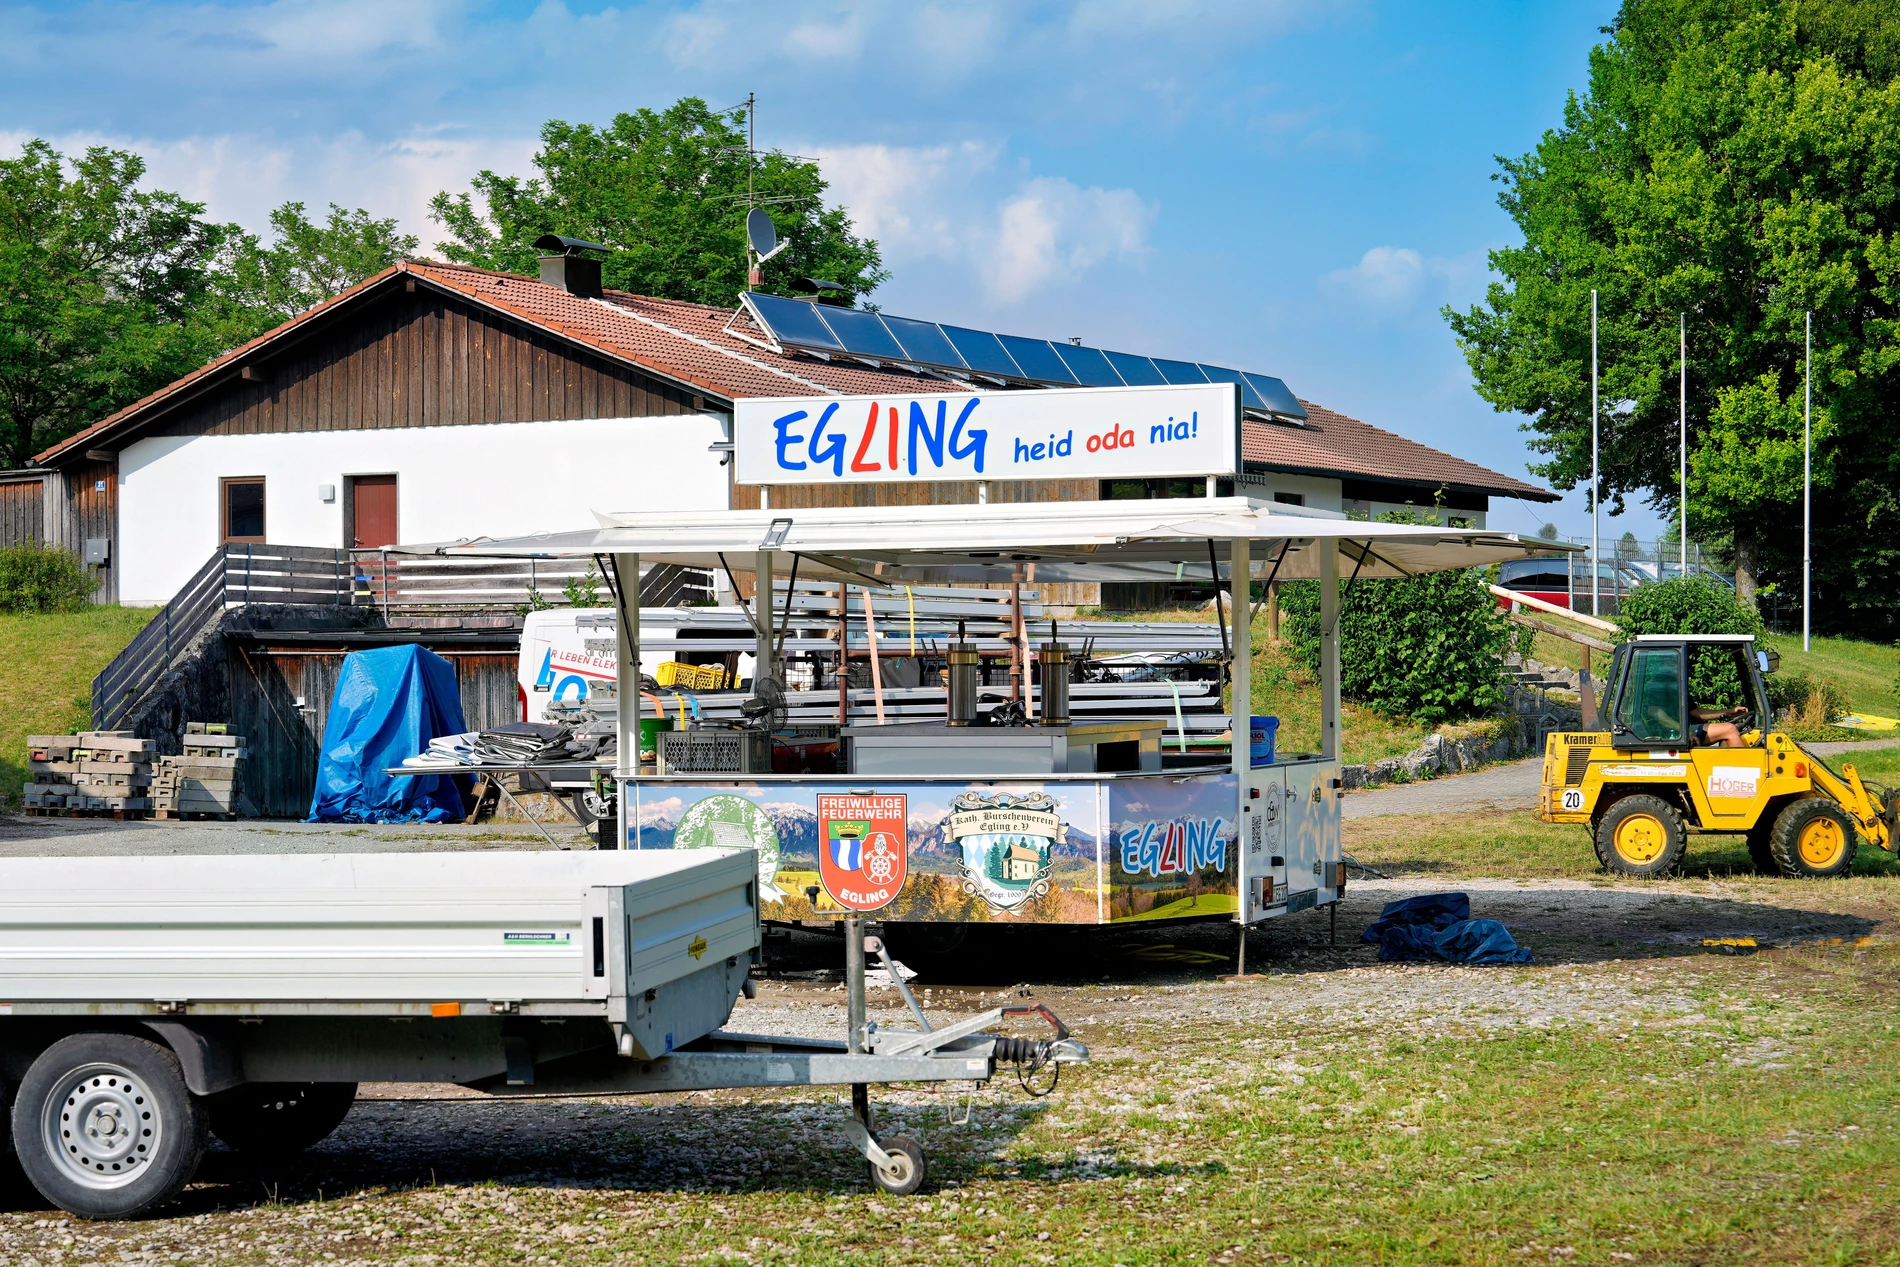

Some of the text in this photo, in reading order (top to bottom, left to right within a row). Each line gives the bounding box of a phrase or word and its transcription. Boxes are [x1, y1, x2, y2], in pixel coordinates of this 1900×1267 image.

[773, 397, 1199, 477] EGLING heid oda nia!
[560, 651, 591, 665] LEBEN
[592, 657, 617, 670] ELEK
[821, 798, 902, 808] FREIWILLIGE
[1565, 792, 1580, 808] 20
[821, 809, 902, 819] FEUERWEHR
[955, 812, 1054, 826] Kath. Burschenverein
[979, 822, 1011, 832] Egling
[1121, 817, 1226, 876] EGLING
[839, 888, 889, 904] EGLING
